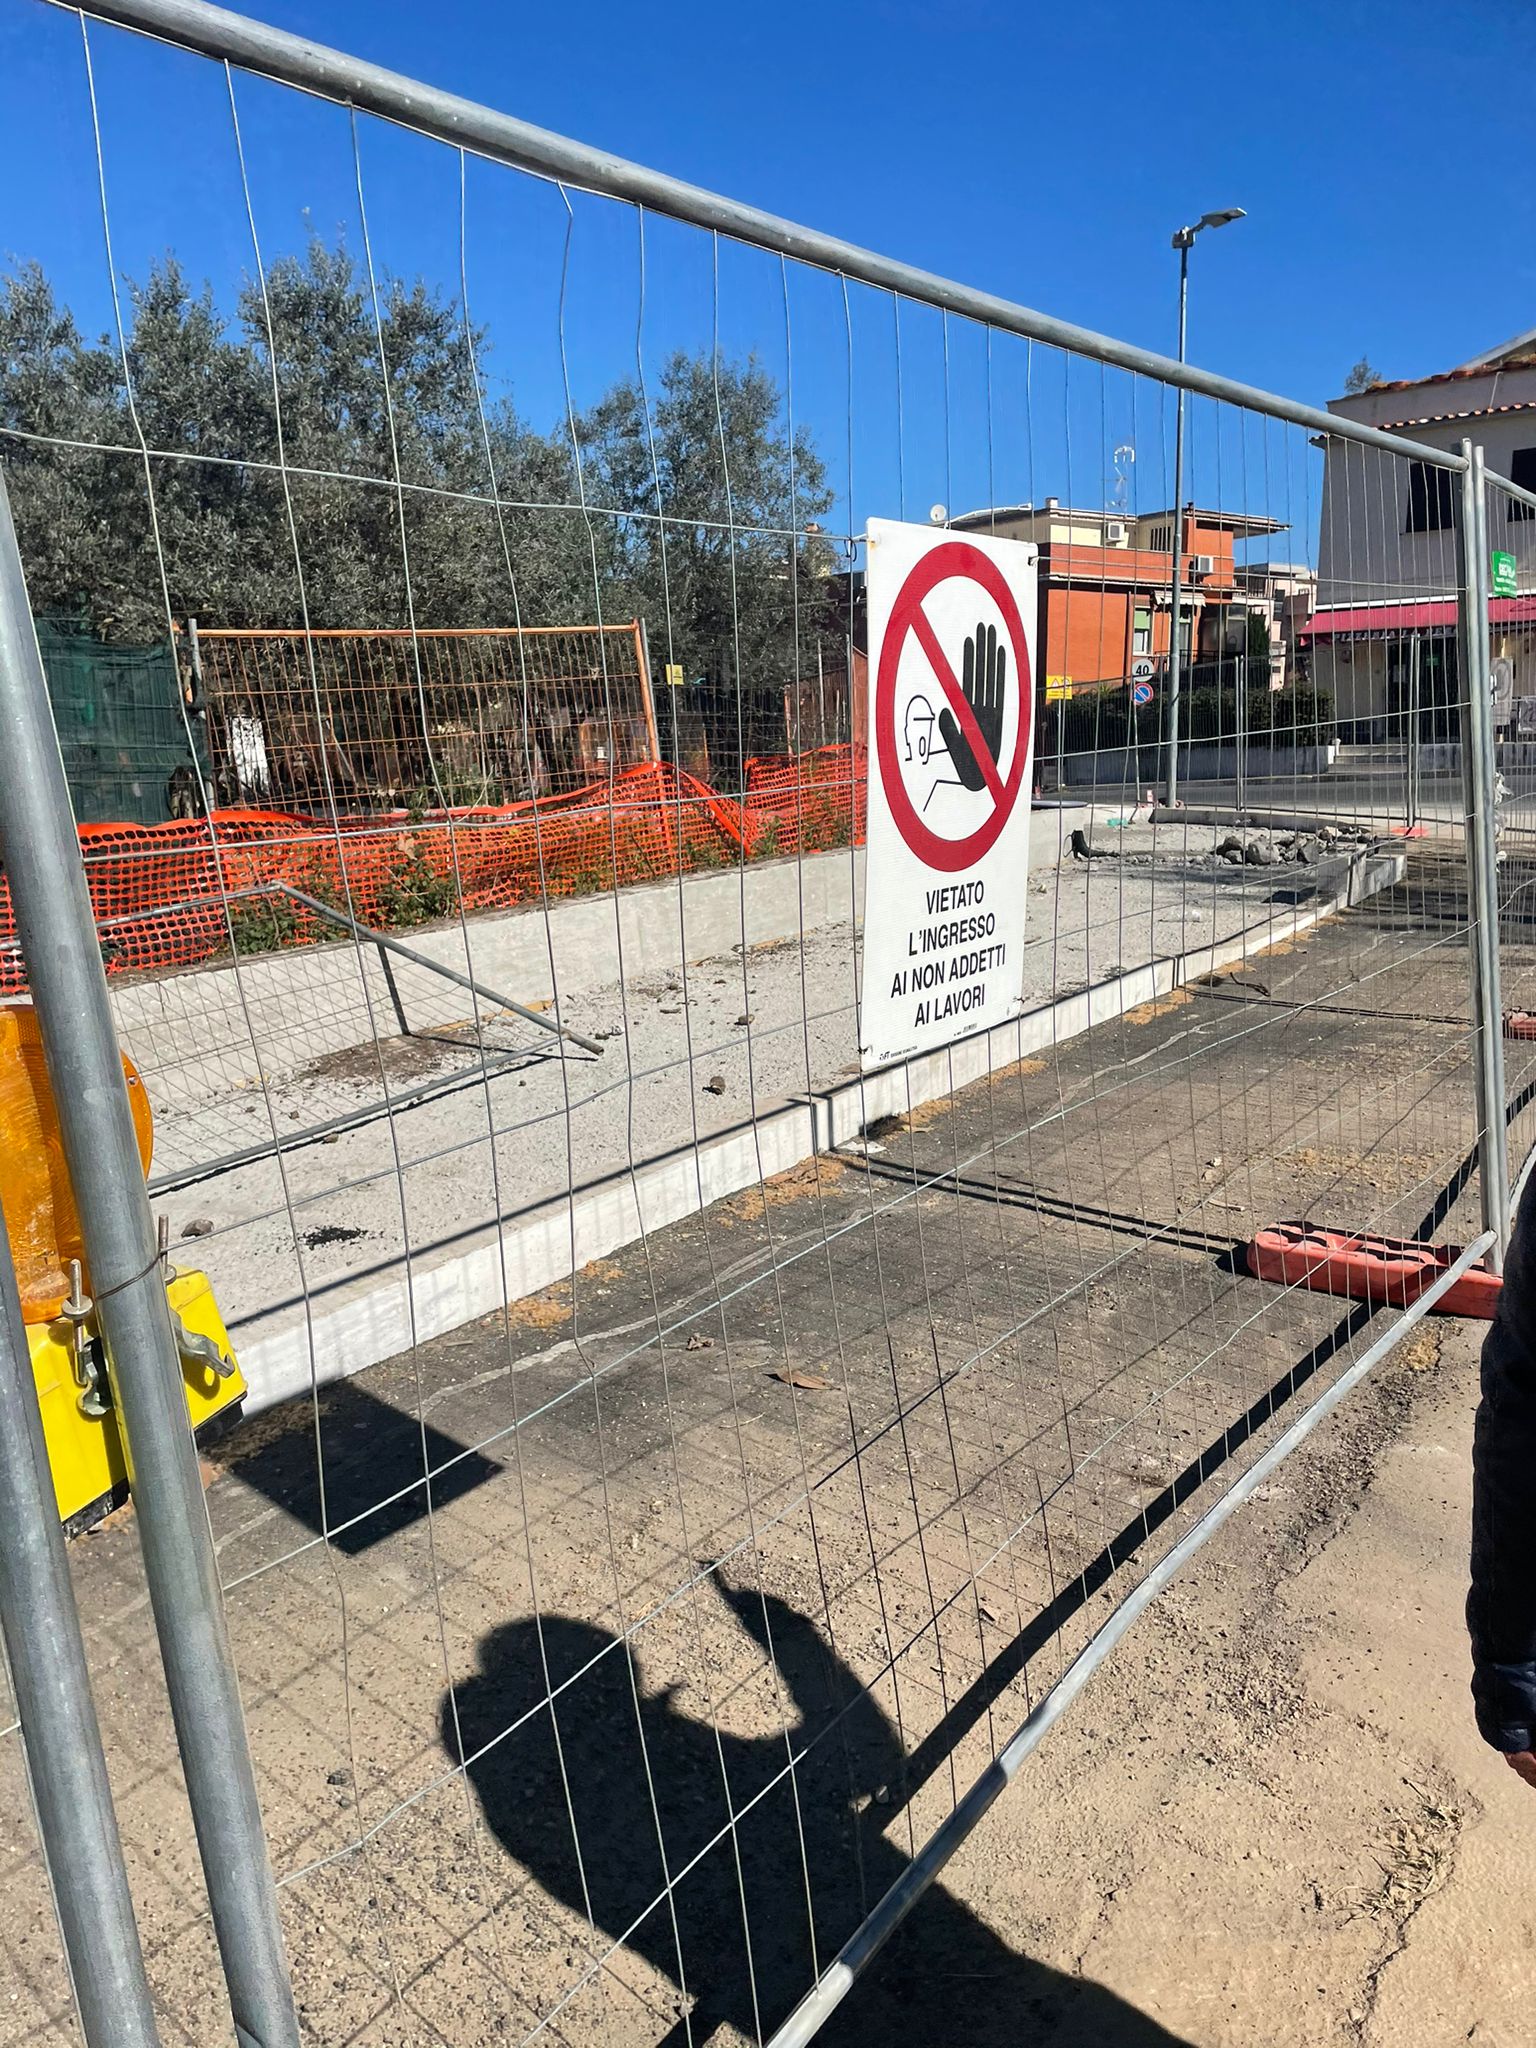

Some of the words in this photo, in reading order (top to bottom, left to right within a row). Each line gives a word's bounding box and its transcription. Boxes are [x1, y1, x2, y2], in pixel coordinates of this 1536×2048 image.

[1136, 664, 1150, 676] 40
[926, 880, 984, 915] VIETATO
[908, 912, 995, 957] L'INGRESSO
[890, 970, 907, 999] AI
[911, 960, 945, 993] NON
[948, 943, 1006, 983] ADDETTI
[914, 1000, 930, 1028] AI
[934, 983, 985, 1022] LAVORI
